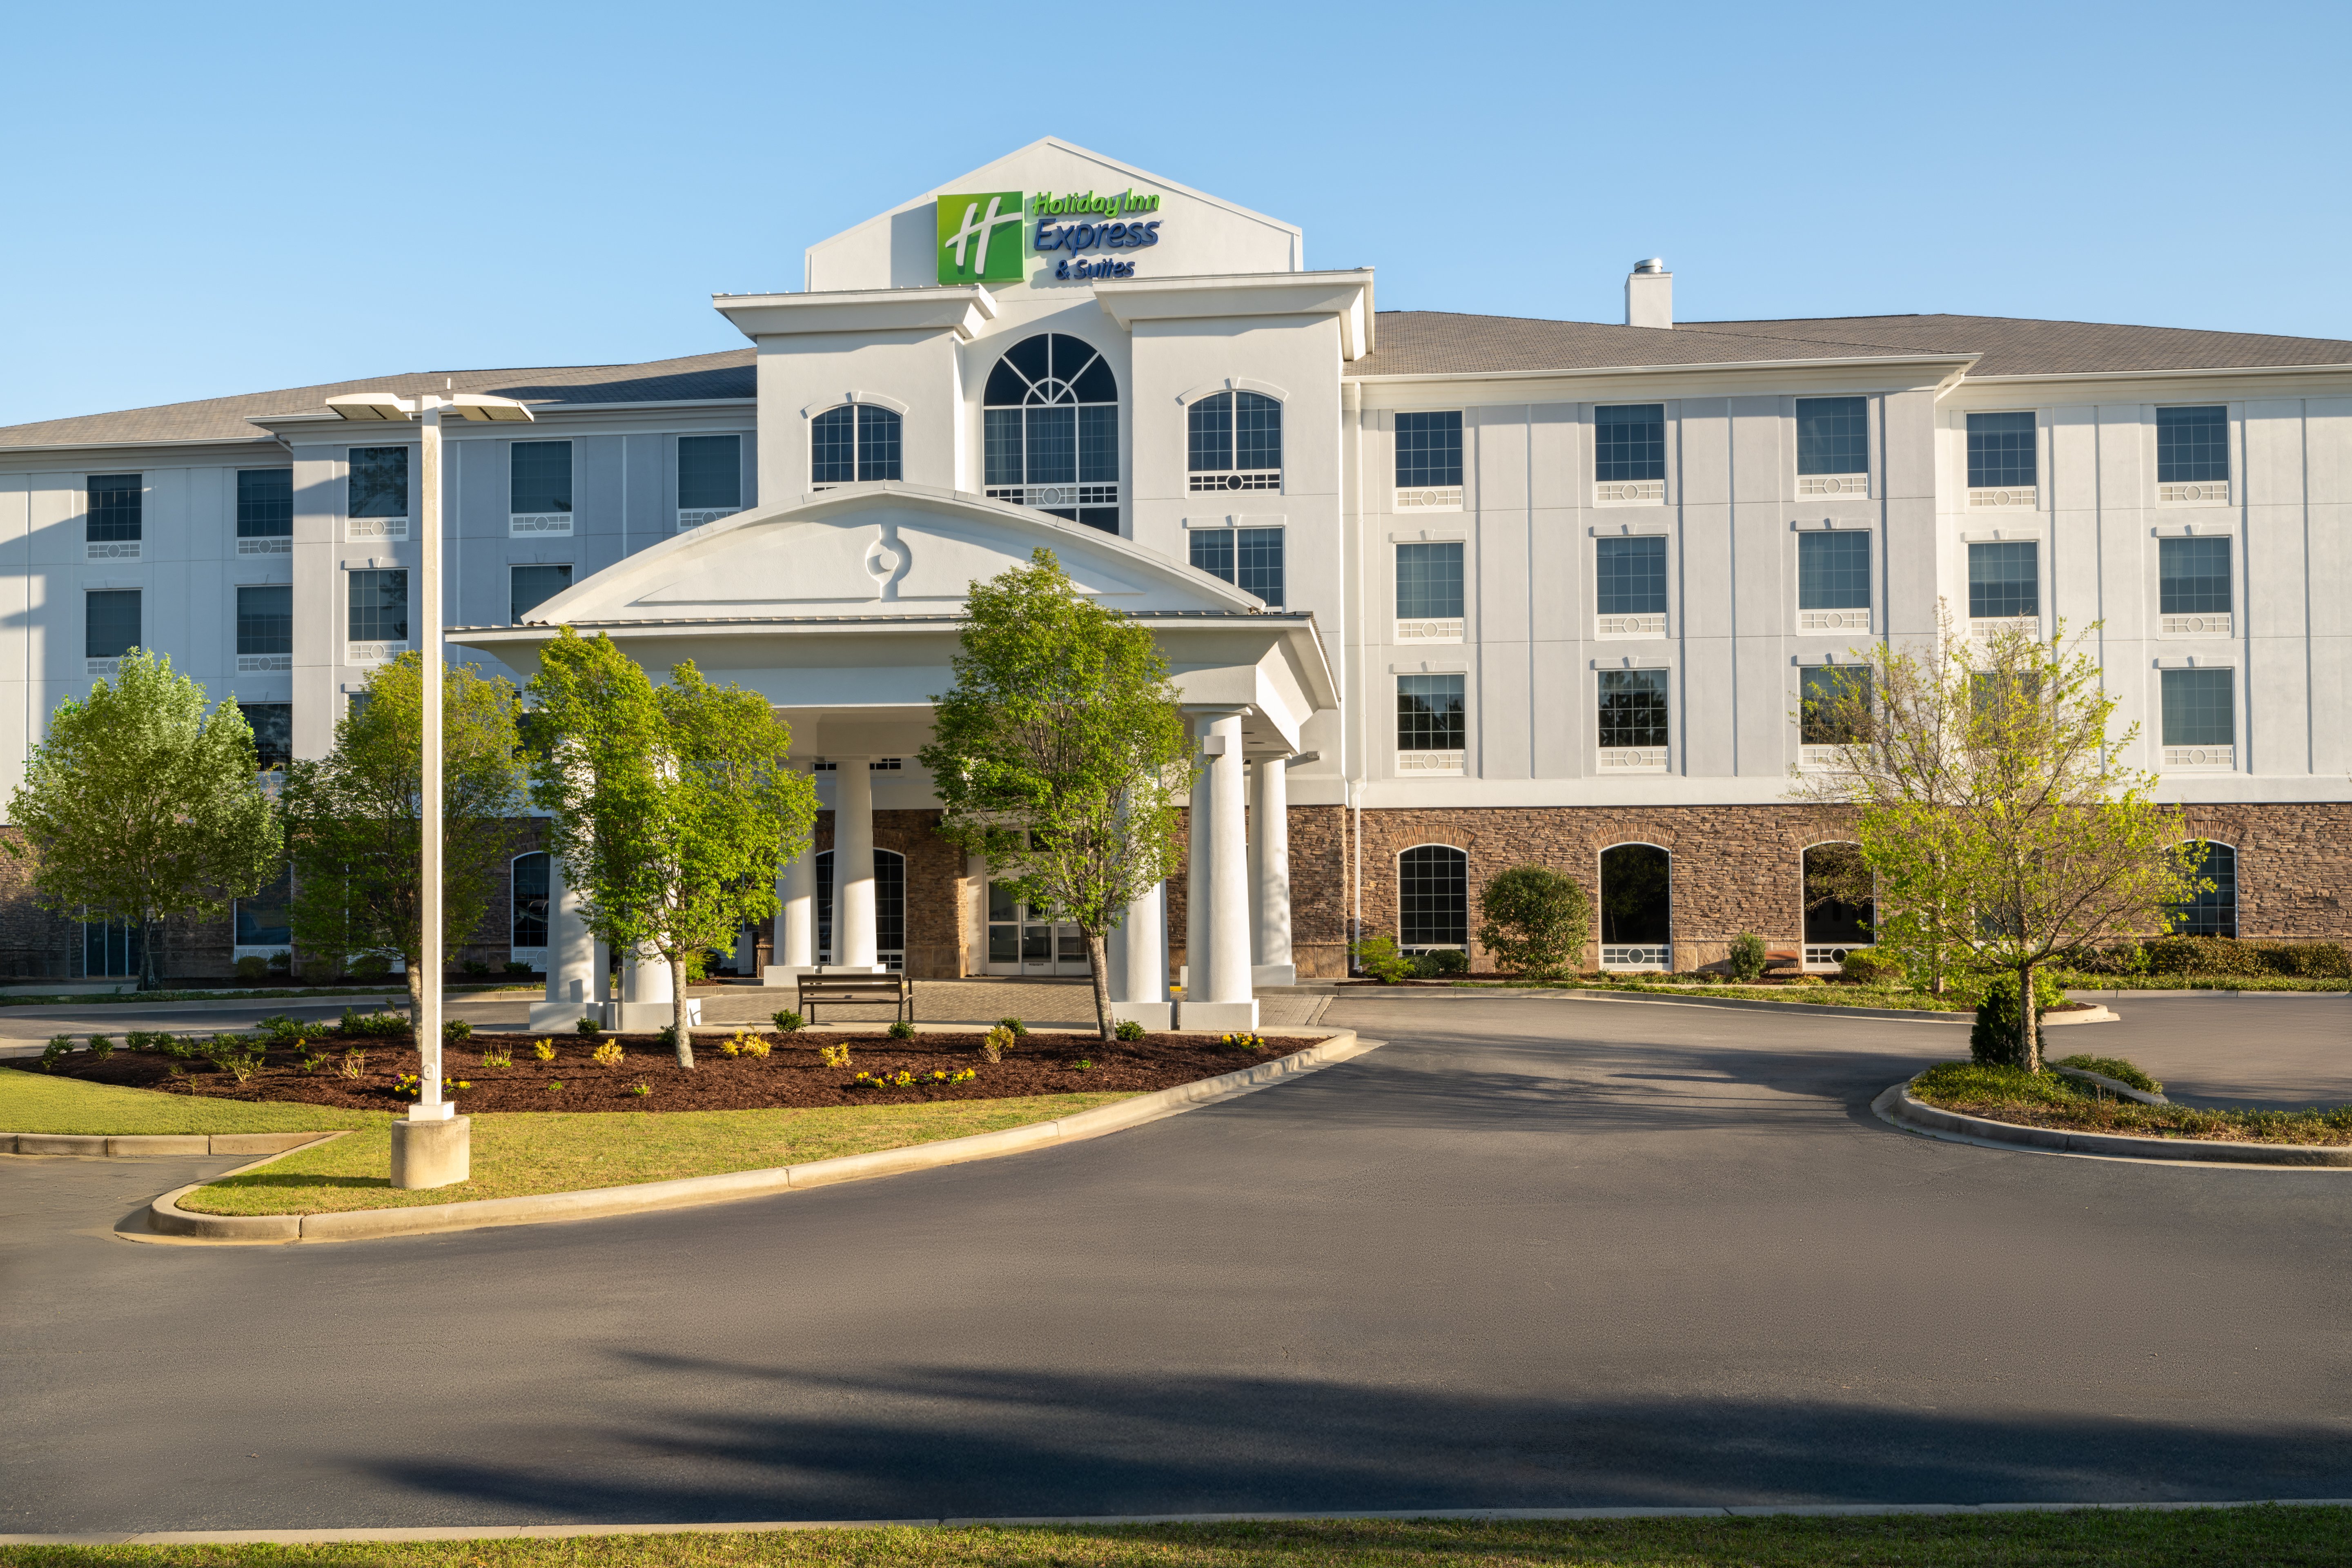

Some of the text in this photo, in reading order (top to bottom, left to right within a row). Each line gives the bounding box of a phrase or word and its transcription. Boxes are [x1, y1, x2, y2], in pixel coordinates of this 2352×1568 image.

[1032, 188, 1160, 218] Holiday Inn
[1033, 218, 1160, 258] Express
[1055, 258, 1135, 280] & Suites
